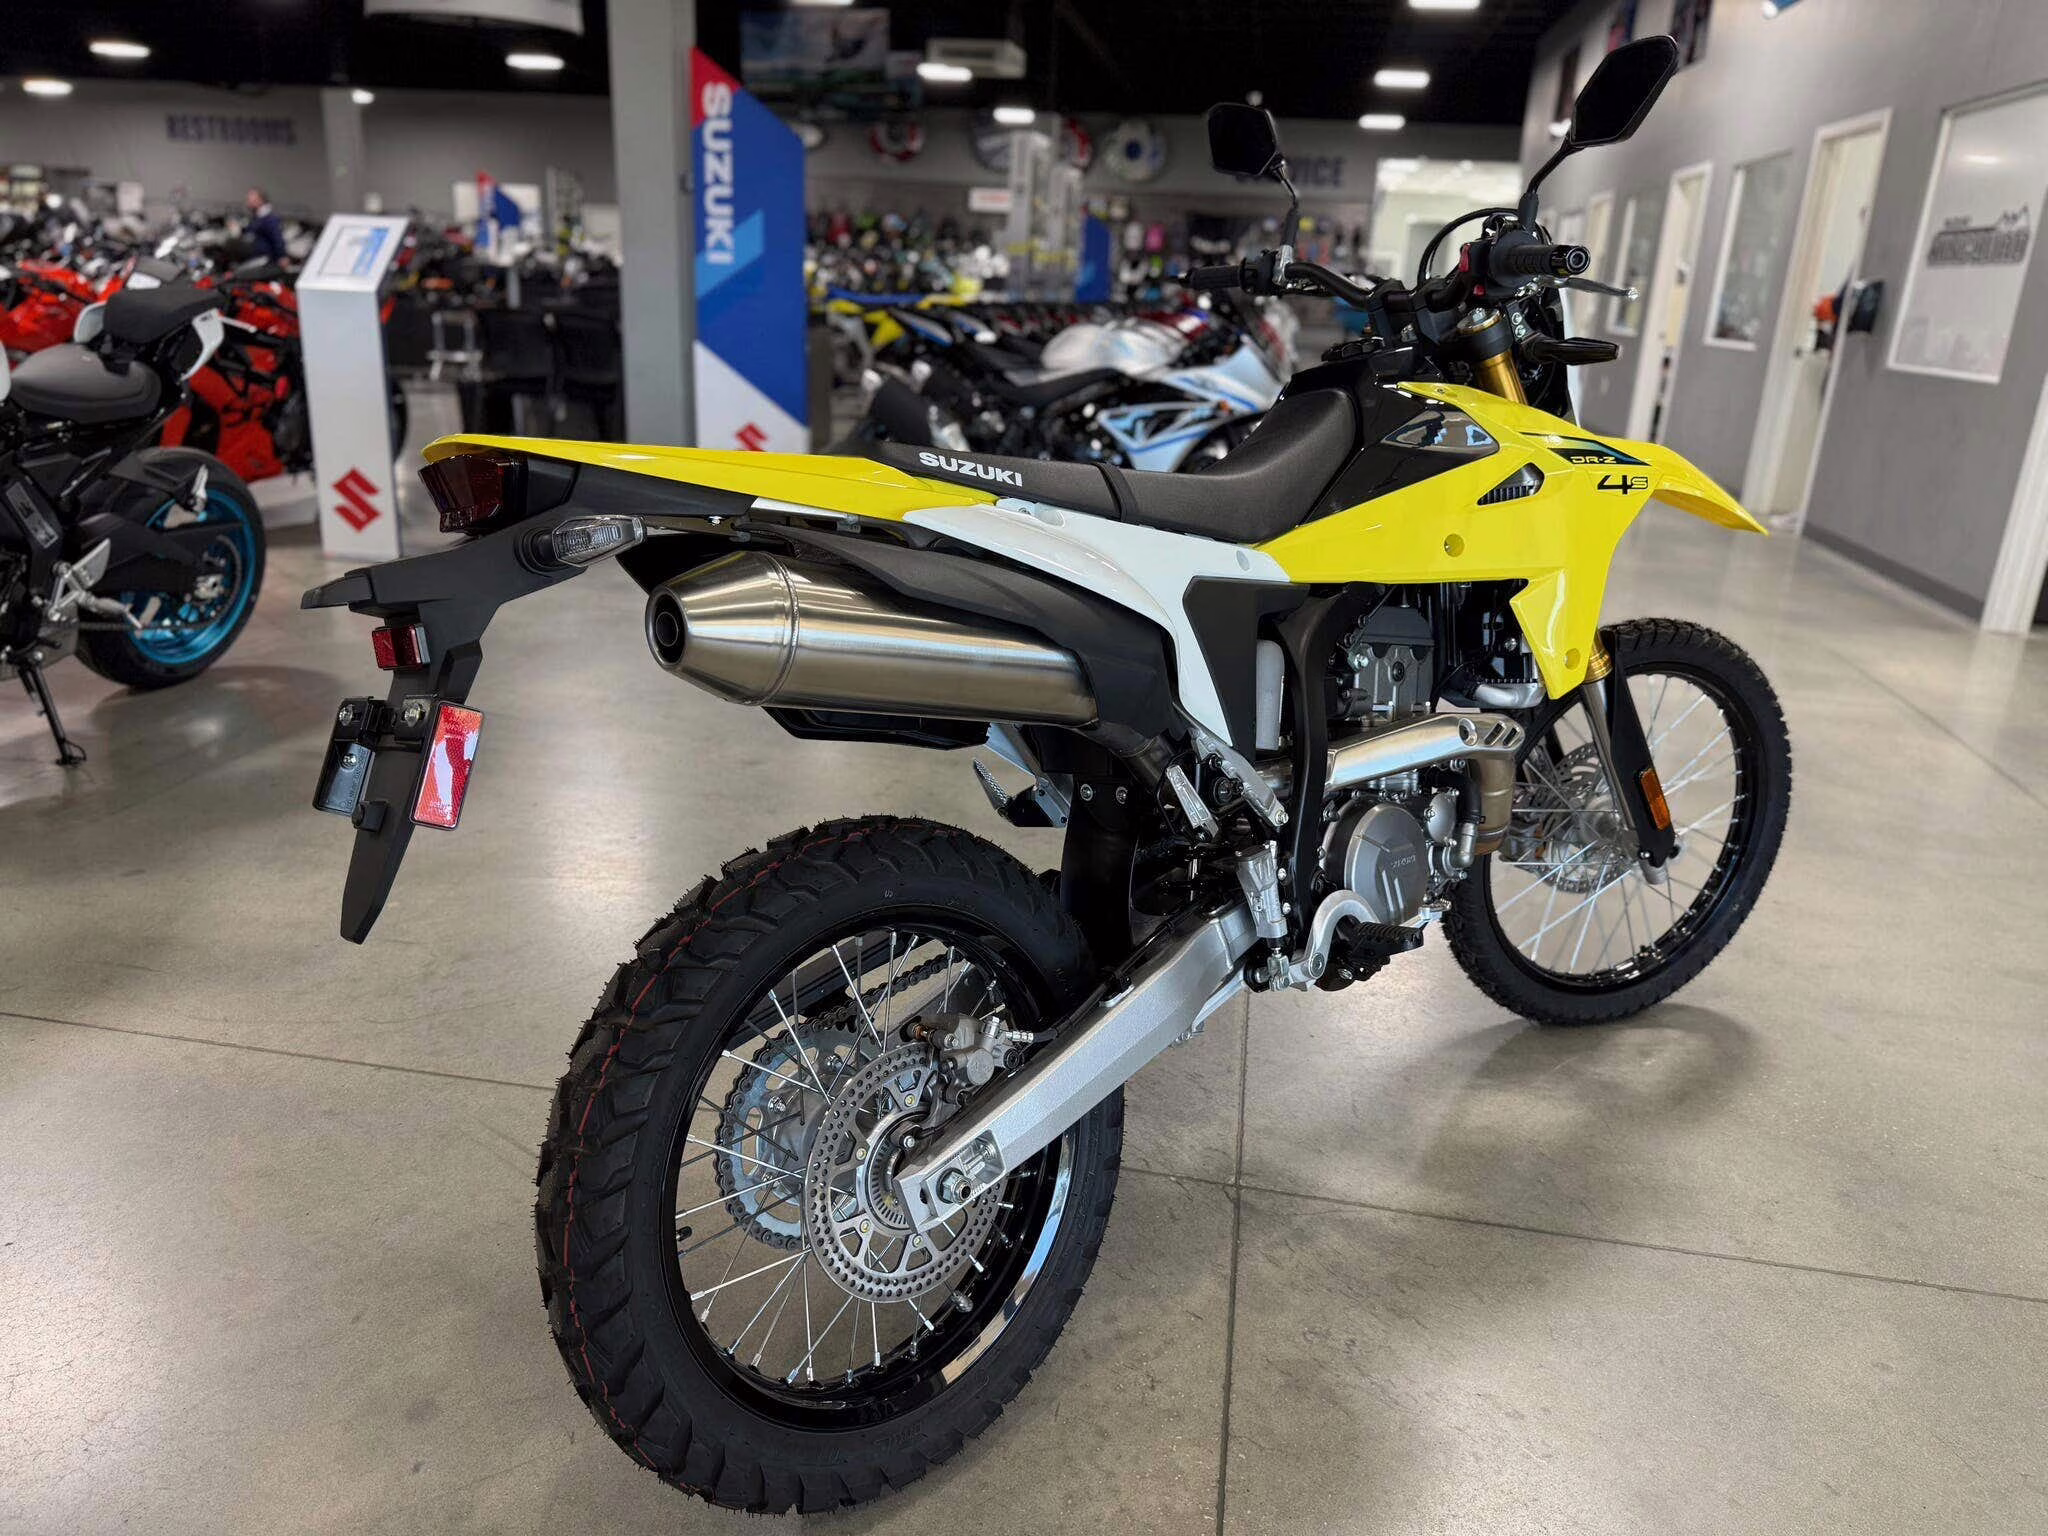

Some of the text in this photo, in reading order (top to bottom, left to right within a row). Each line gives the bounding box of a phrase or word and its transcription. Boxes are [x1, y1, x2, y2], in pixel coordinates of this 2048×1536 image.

[702, 81, 735, 265] SUZUKI
[919, 451, 1023, 487] SUZUKI
[1570, 455, 1617, 464] DR-Z
